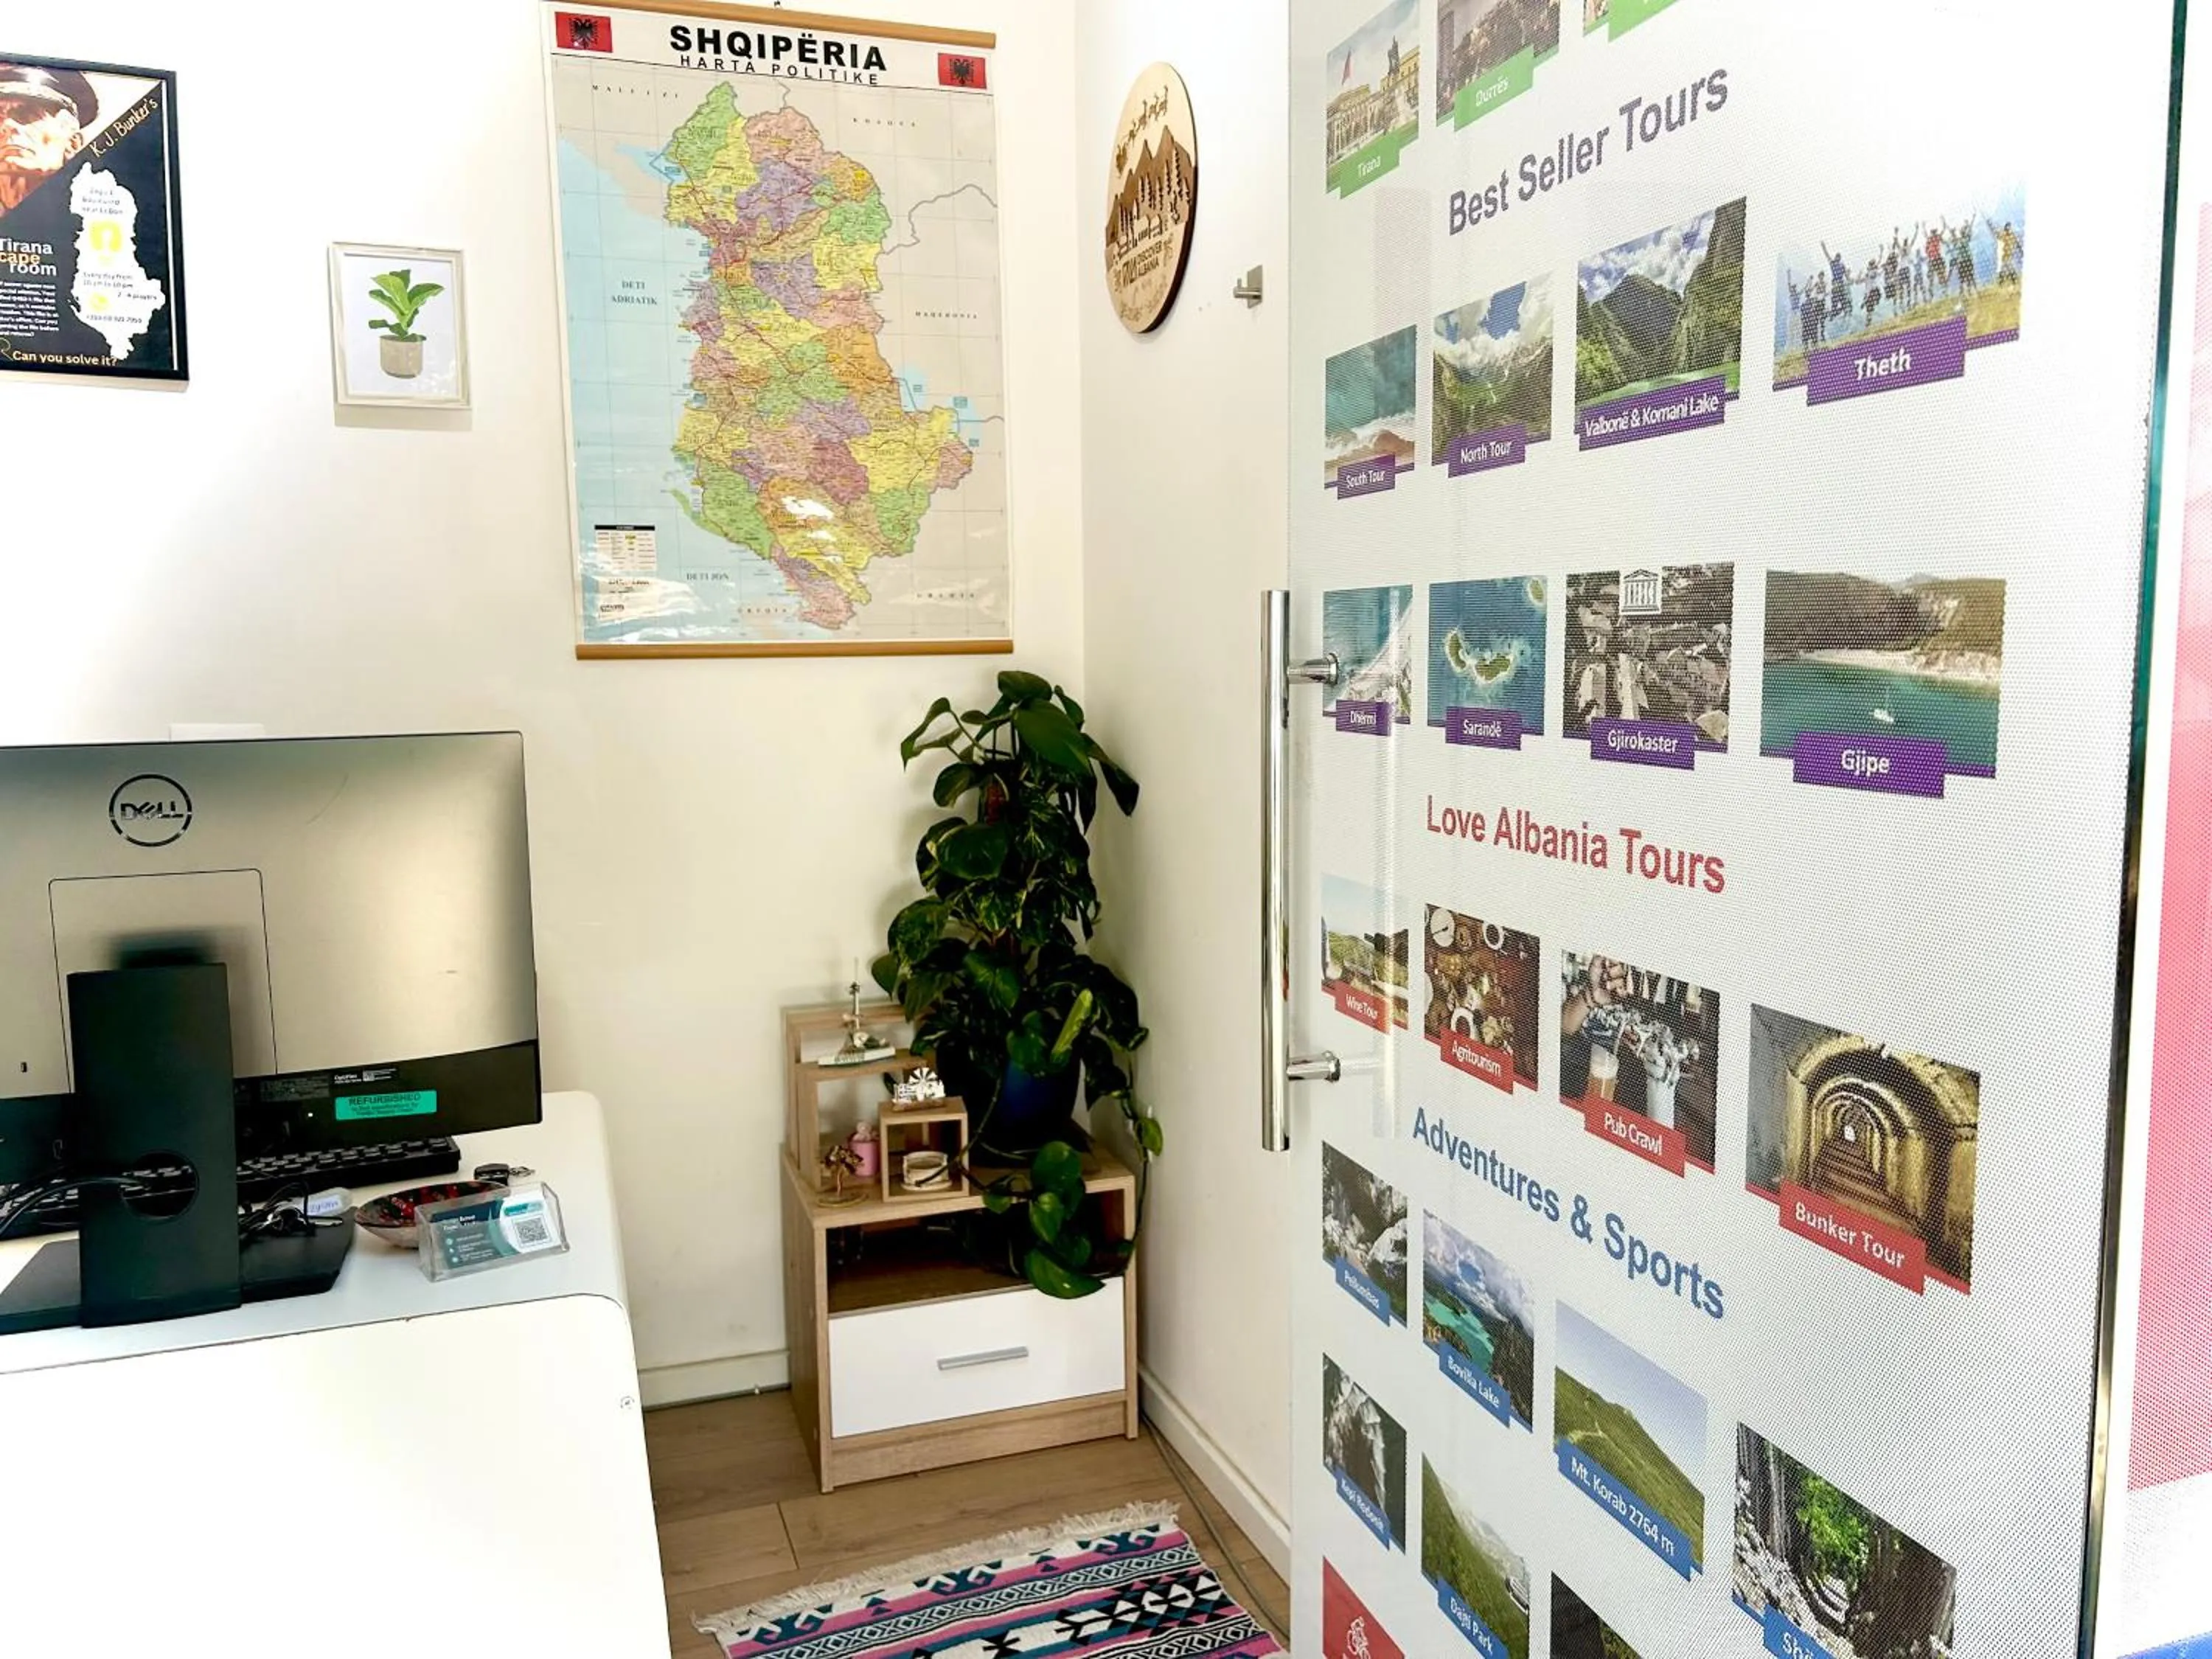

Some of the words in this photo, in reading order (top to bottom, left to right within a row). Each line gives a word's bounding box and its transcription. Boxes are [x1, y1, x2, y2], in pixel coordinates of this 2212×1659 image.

[669, 24, 887, 72] SHQIPËRIA
[680, 55, 756, 72] HARTA
[771, 63, 878, 85] POLITIKE
[104, 131, 118, 147] J.
[113, 98, 158, 136] Bunker's
[1450, 168, 1509, 237] Best
[1517, 126, 1610, 202] Seller
[1618, 68, 1729, 153] Tours
[0, 237, 54, 254] Tirana
[10, 263, 57, 276] room
[12, 350, 37, 361] Can
[39, 353, 63, 364] you
[66, 353, 100, 365] solve
[101, 355, 119, 366] it?
[1854, 346, 1912, 380] Theth
[1584, 410, 1630, 438] Valbonë
[1630, 408, 1641, 428] &
[1642, 398, 1688, 425] Komani
[1689, 394, 1719, 415] Lake
[1460, 444, 1488, 465] North
[1489, 440, 1513, 460] Tour
[1346, 469, 1368, 489] South
[1368, 468, 1386, 486] Tour
[1462, 717, 1503, 737] Sarandë
[1607, 729, 1679, 756] Gjirokaster
[1840, 748, 1891, 777] Gjipe
[120, 800, 184, 821] DELL
[1427, 794, 1486, 844] Love
[1493, 806, 1609, 869] Albania
[1618, 827, 1726, 894] Tours
[1451, 1038, 1503, 1077] Agritourism
[1604, 1112, 1628, 1140] Pub
[1629, 1121, 1663, 1157] Crawl
[1413, 1106, 1561, 1222] Adventures
[1571, 1193, 1593, 1244] &
[1604, 1211, 1725, 1320] Sports
[1795, 1201, 1857, 1245] Bunker
[1862, 1230, 1906, 1269] Tour
[1478, 1380, 1500, 1409] Lake
[1571, 1455, 1591, 1487] Mt.
[1593, 1474, 1628, 1516] Korab
[1629, 1505, 1659, 1543] 2764
[1660, 1534, 1675, 1557] m
[1472, 1619, 1494, 1657] Park
